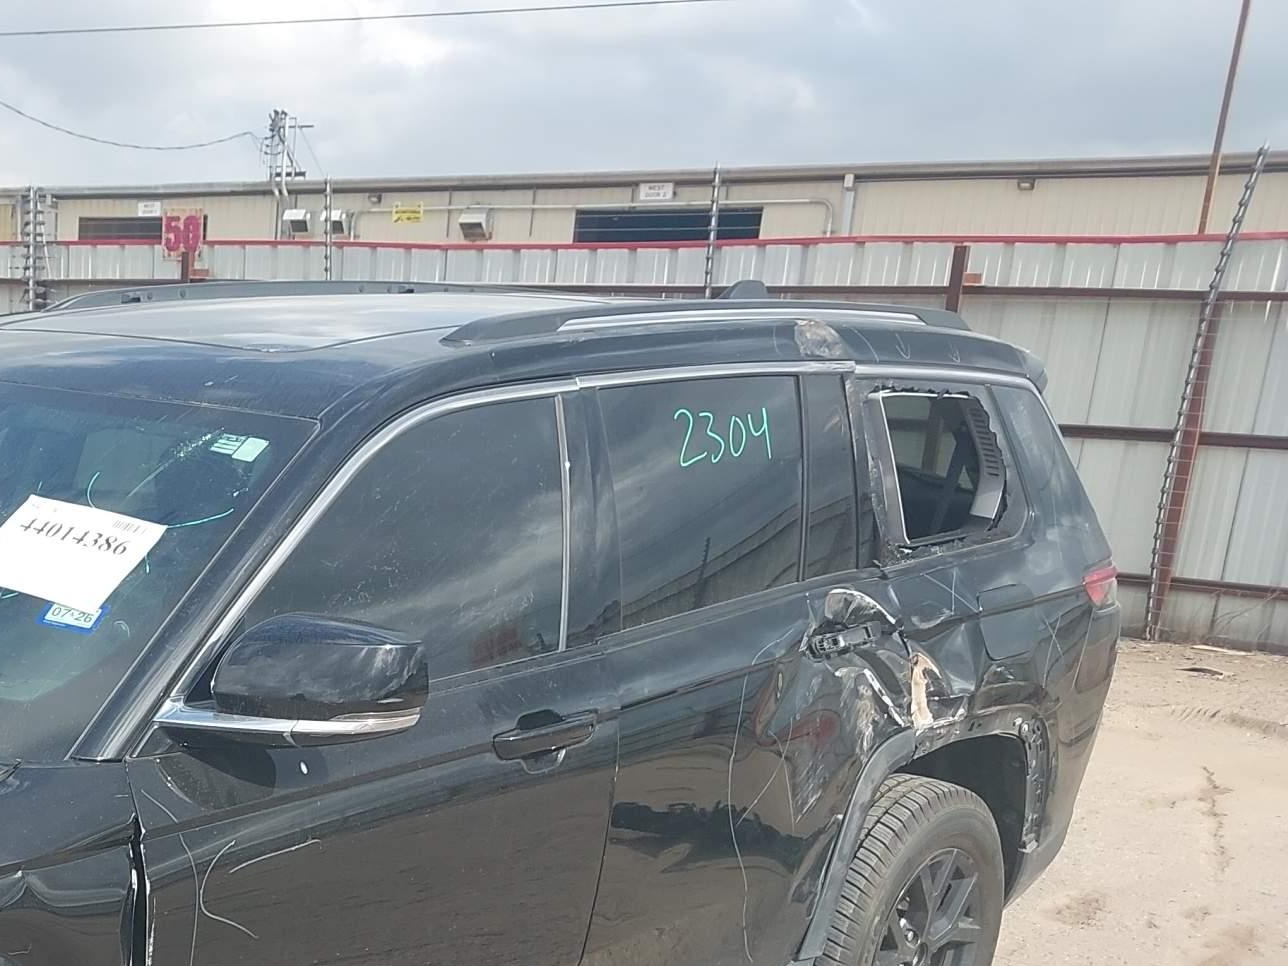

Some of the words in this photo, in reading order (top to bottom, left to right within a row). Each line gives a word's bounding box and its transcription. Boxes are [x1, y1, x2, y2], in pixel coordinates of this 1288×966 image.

[164, 214, 202, 253] 50
[673, 406, 773, 467] 2304
[19, 518, 131, 556] 44014386
